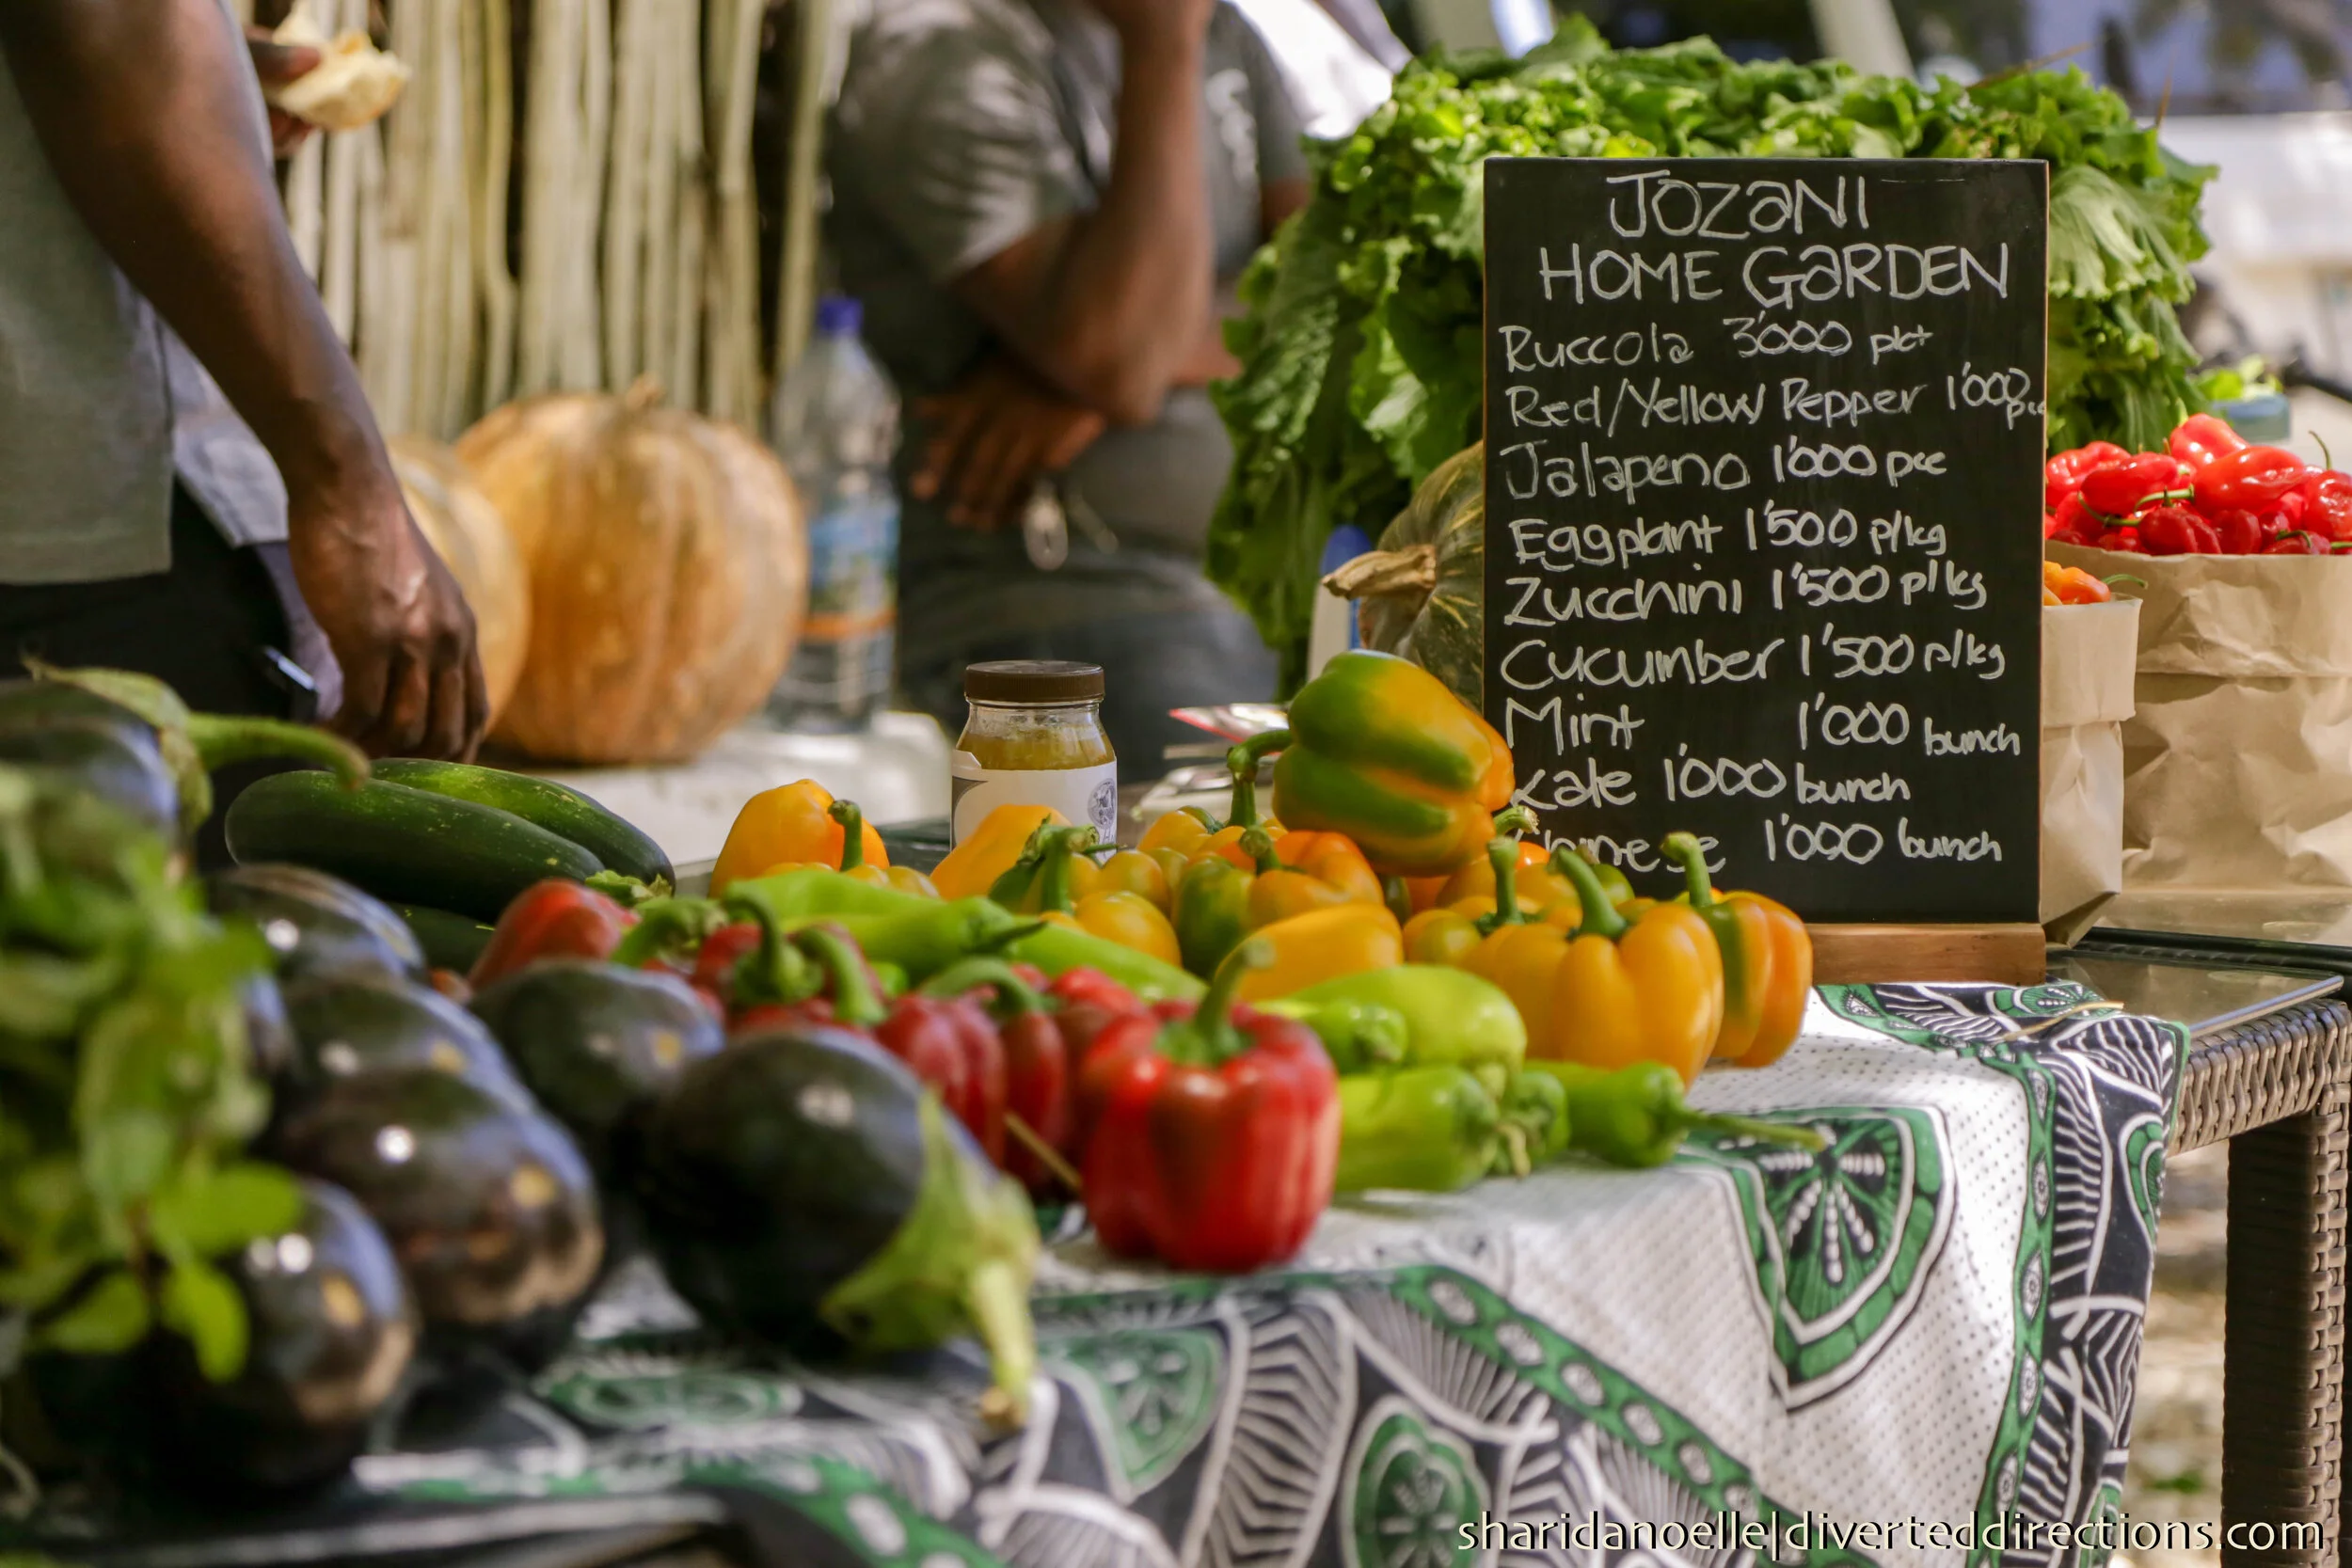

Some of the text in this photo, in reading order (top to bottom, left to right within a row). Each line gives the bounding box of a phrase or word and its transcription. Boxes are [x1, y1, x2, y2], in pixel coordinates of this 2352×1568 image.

[1539, 244, 1722, 304] HOME
[1499, 323, 1693, 372] Ruccola
[1724, 310, 1851, 356] 3'000
[1505, 377, 1765, 437] Red/Yellow
[1781, 378, 1926, 427] Pepper
[1947, 361, 2030, 410] 1'000
[1500, 439, 1749, 504] Jalapeno
[1774, 436, 1877, 482] 1'000
[1509, 499, 1946, 570] Eggplant 1'500 p/kg
[1504, 560, 1986, 626] Zucchini 1'500 p/kg
[1501, 623, 2005, 689] Cucumber 1'500 p/kg
[1506, 692, 2020, 755] Mint 1'000 bunch
[1510, 743, 1910, 810] Kale 1'000 bunch
[1515, 814, 2001, 873] hnee 1'000 bunch
